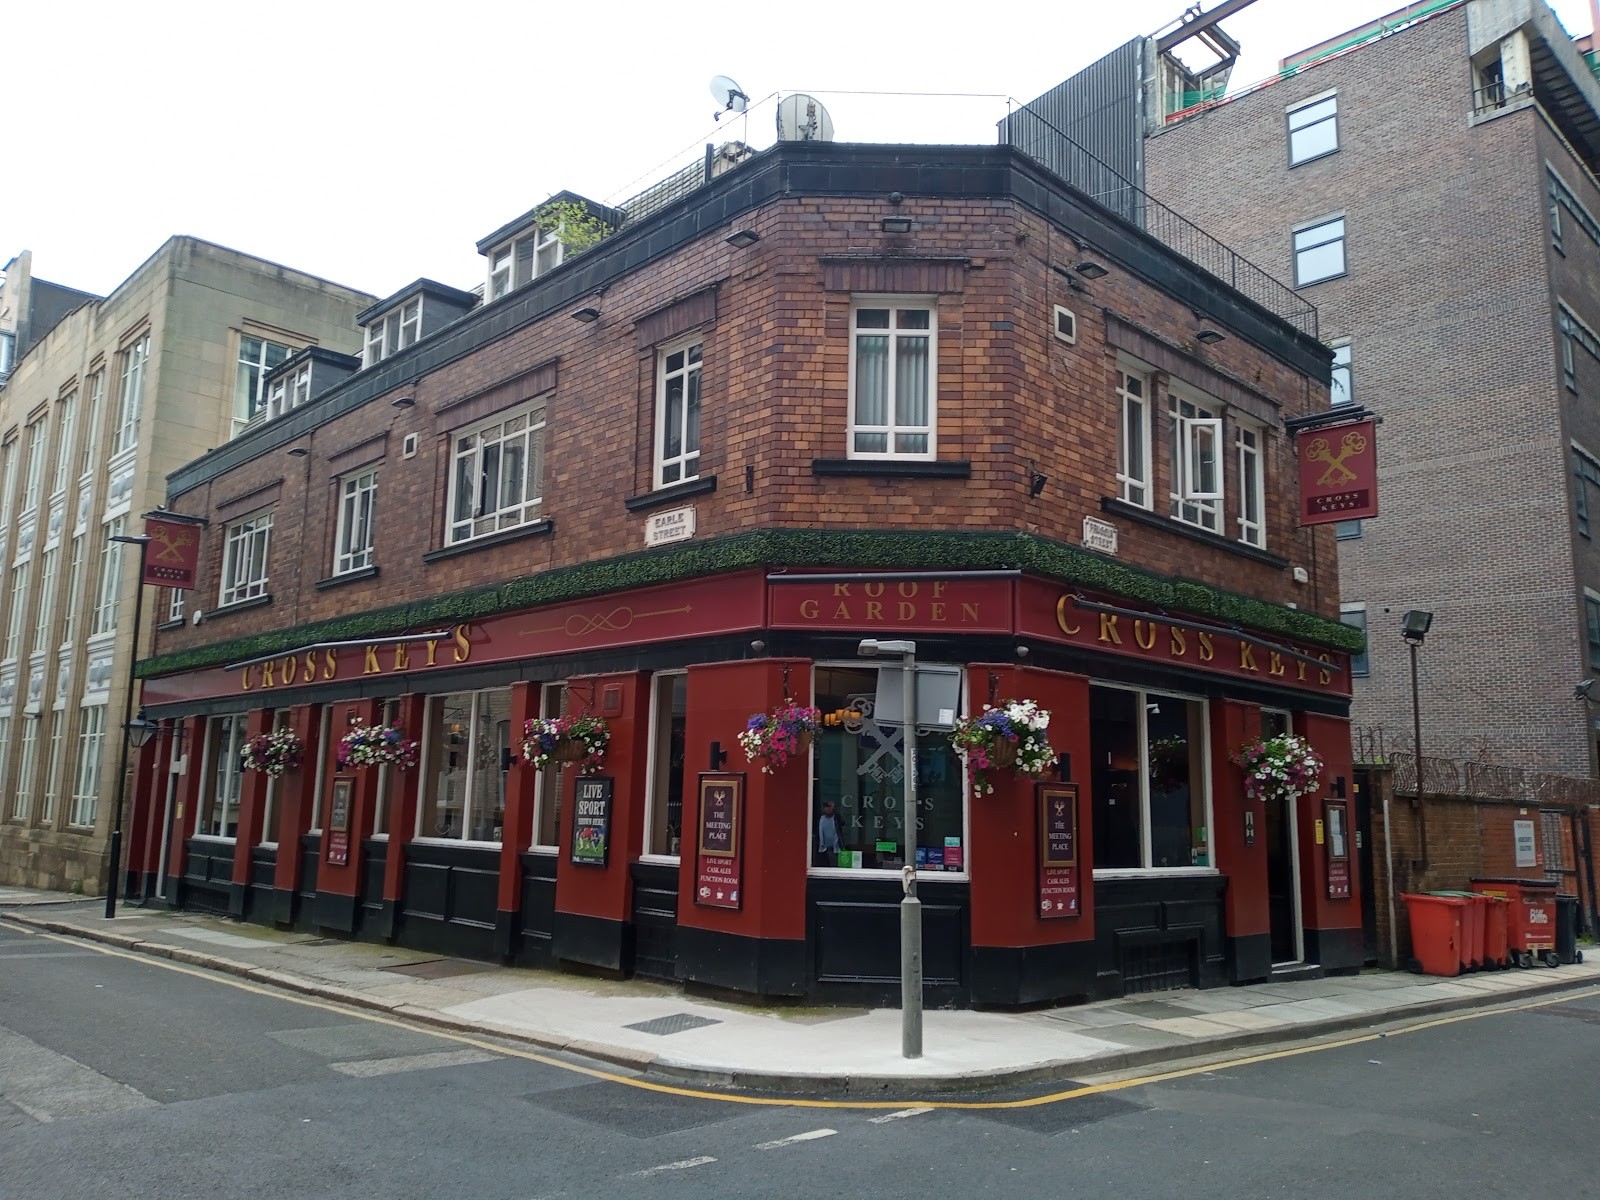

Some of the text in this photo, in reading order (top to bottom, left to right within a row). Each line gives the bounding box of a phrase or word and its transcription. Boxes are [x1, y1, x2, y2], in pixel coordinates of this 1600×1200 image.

[1316, 493, 1359, 504] CROSS
[1322, 502, 1355, 512] KEYS
[655, 513, 684, 528] EARLE
[653, 525, 686, 540] STREET
[833, 581, 947, 598] ROOF
[799, 600, 980, 622] GARDEN
[1056, 594, 1333, 685] CROSS KEYS
[242, 624, 473, 690] CROSS KEYS
[583, 784, 603, 798] LIVE
[578, 801, 606, 816] SPORT
[841, 794, 934, 810] CROS
[706, 822, 732, 830] MEETING
[851, 816, 925, 830] KEYS
[1054, 822, 1065, 830] THE
[708, 832, 728, 840] PLACE
[1048, 832, 1072, 840] MEETING
[718, 858, 732, 866] SPORT
[700, 876, 738, 884] FUNCTION ROOM
[1062, 886, 1076, 894] ROOM
